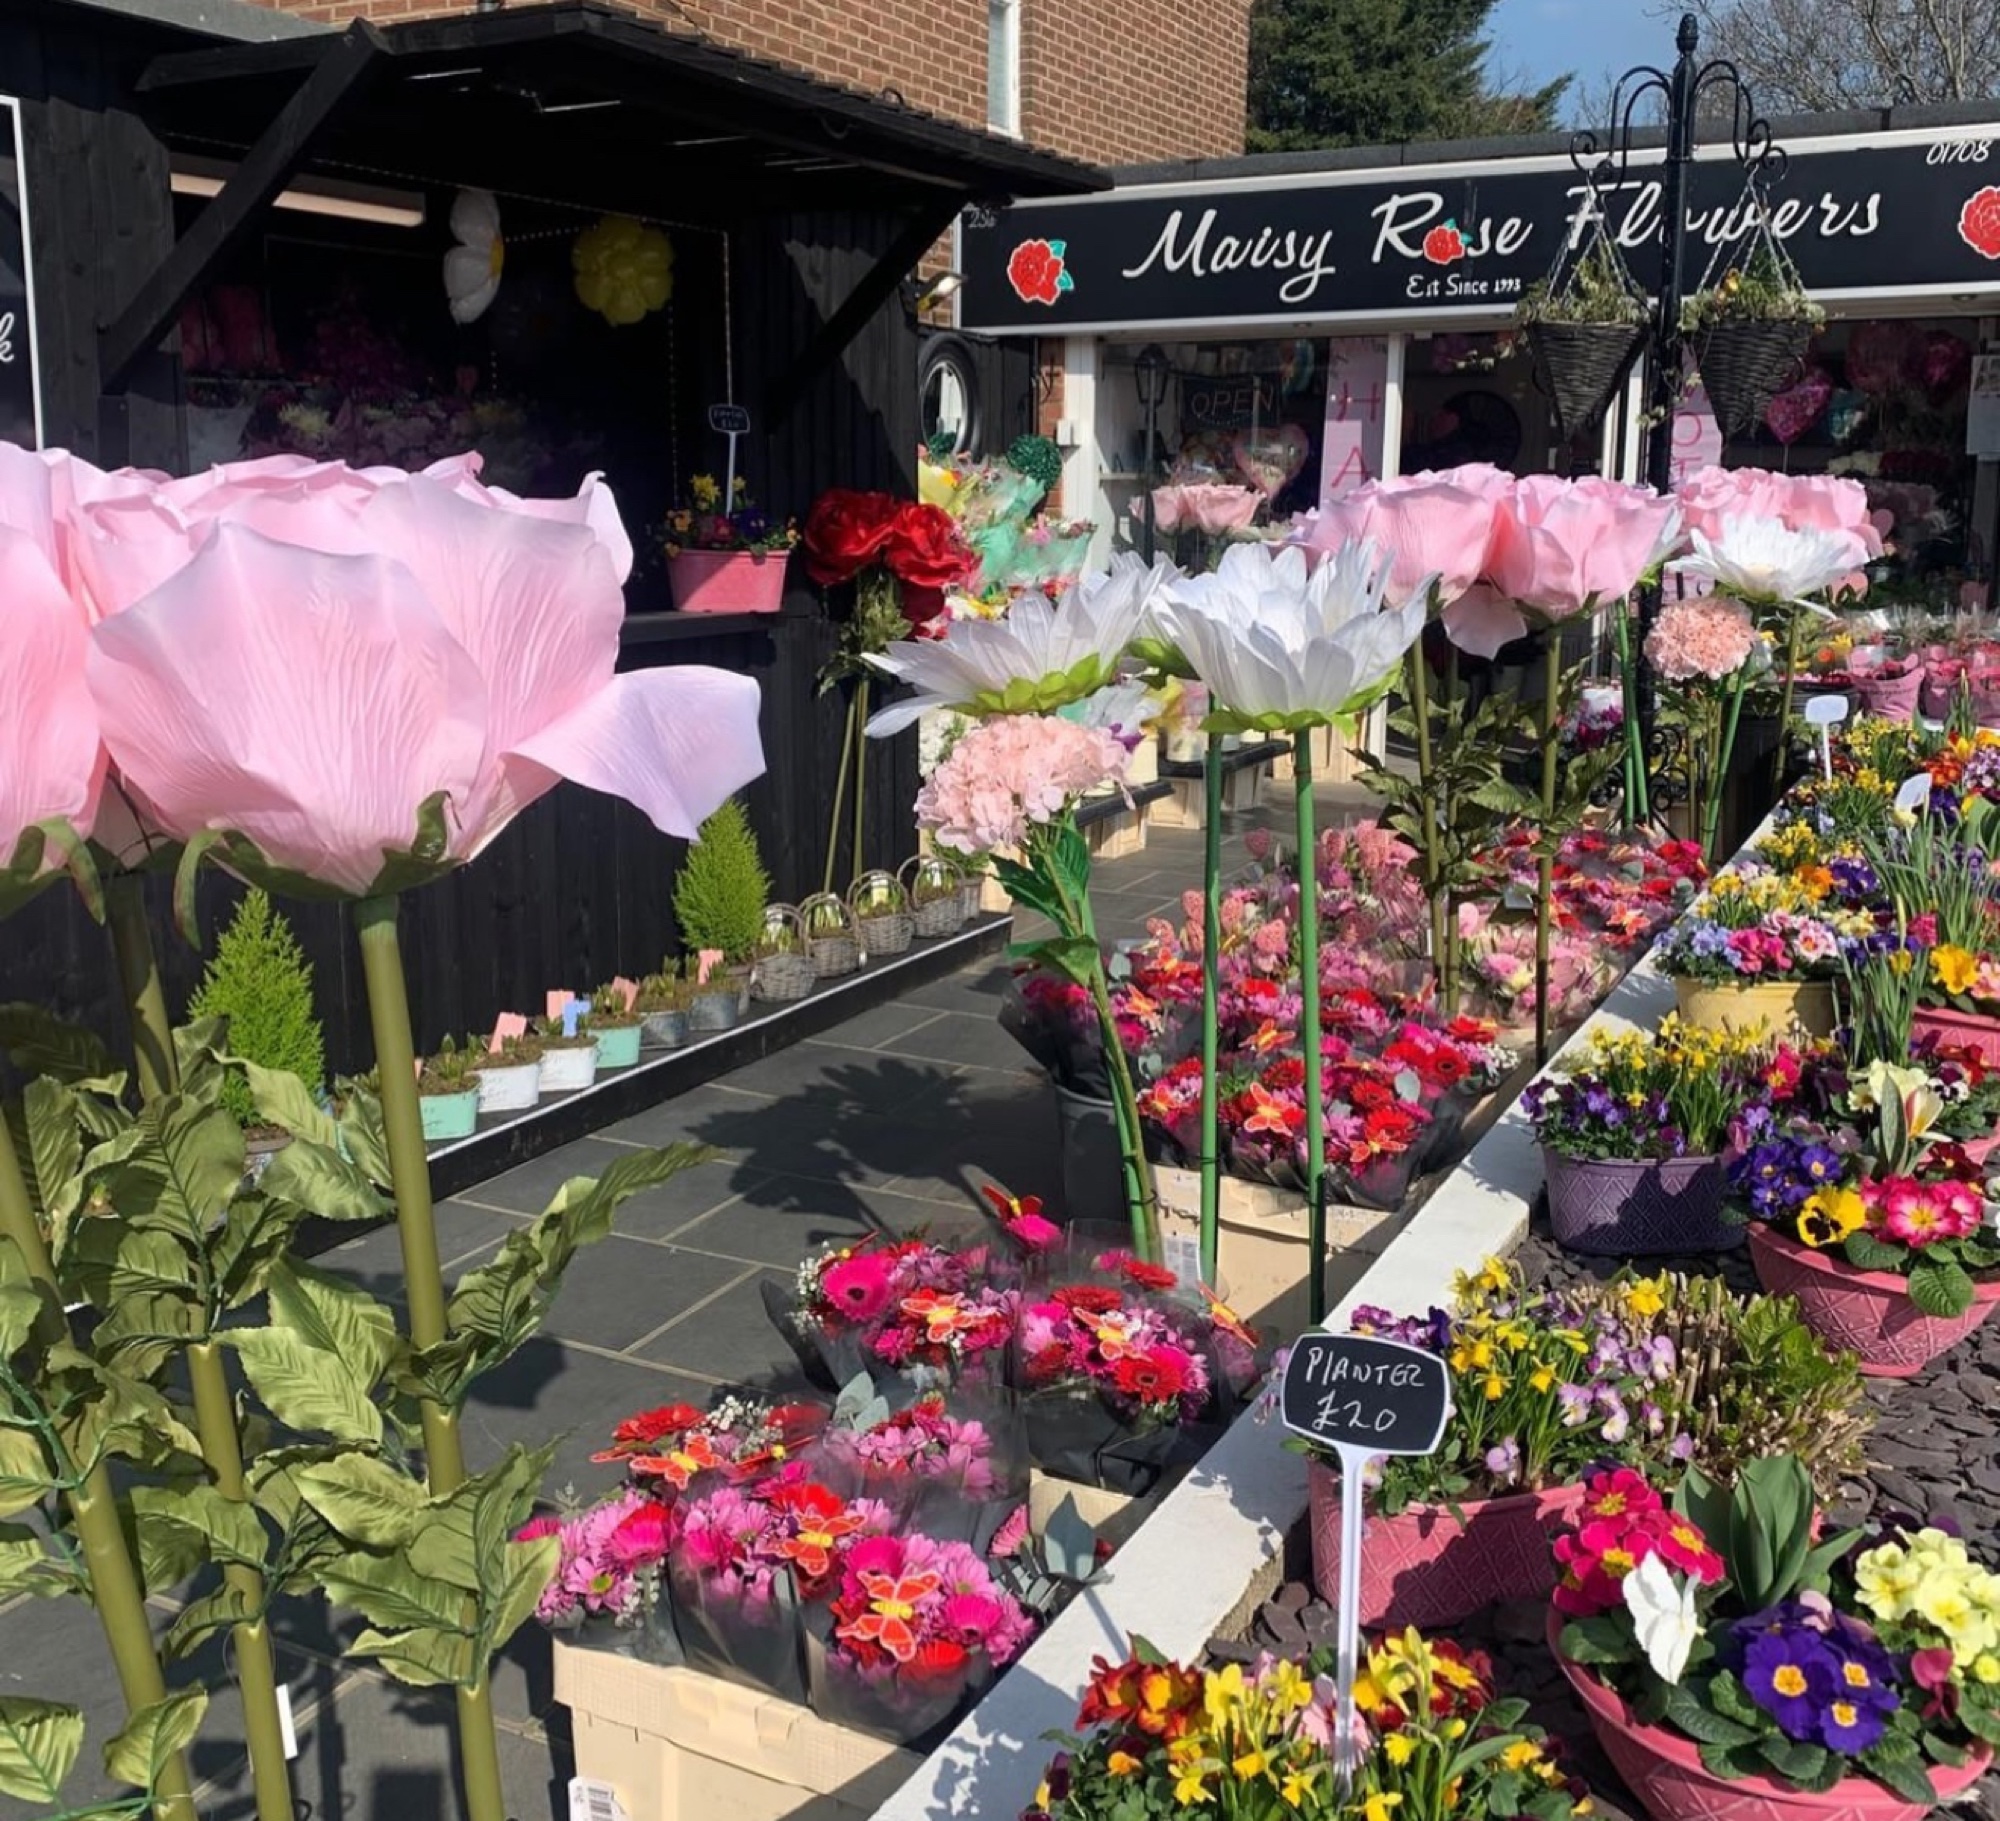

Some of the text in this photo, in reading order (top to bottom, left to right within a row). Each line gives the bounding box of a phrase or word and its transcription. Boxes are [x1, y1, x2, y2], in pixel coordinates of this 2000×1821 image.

[1926, 140, 1991, 166] 01708
[1122, 210, 1336, 302] Maisy
[1565, 180, 1881, 250] Flwers
[1446, 273, 1488, 295] Since
[1191, 384, 1274, 418] OPEN
[1311, 1389, 1397, 1432] £20
